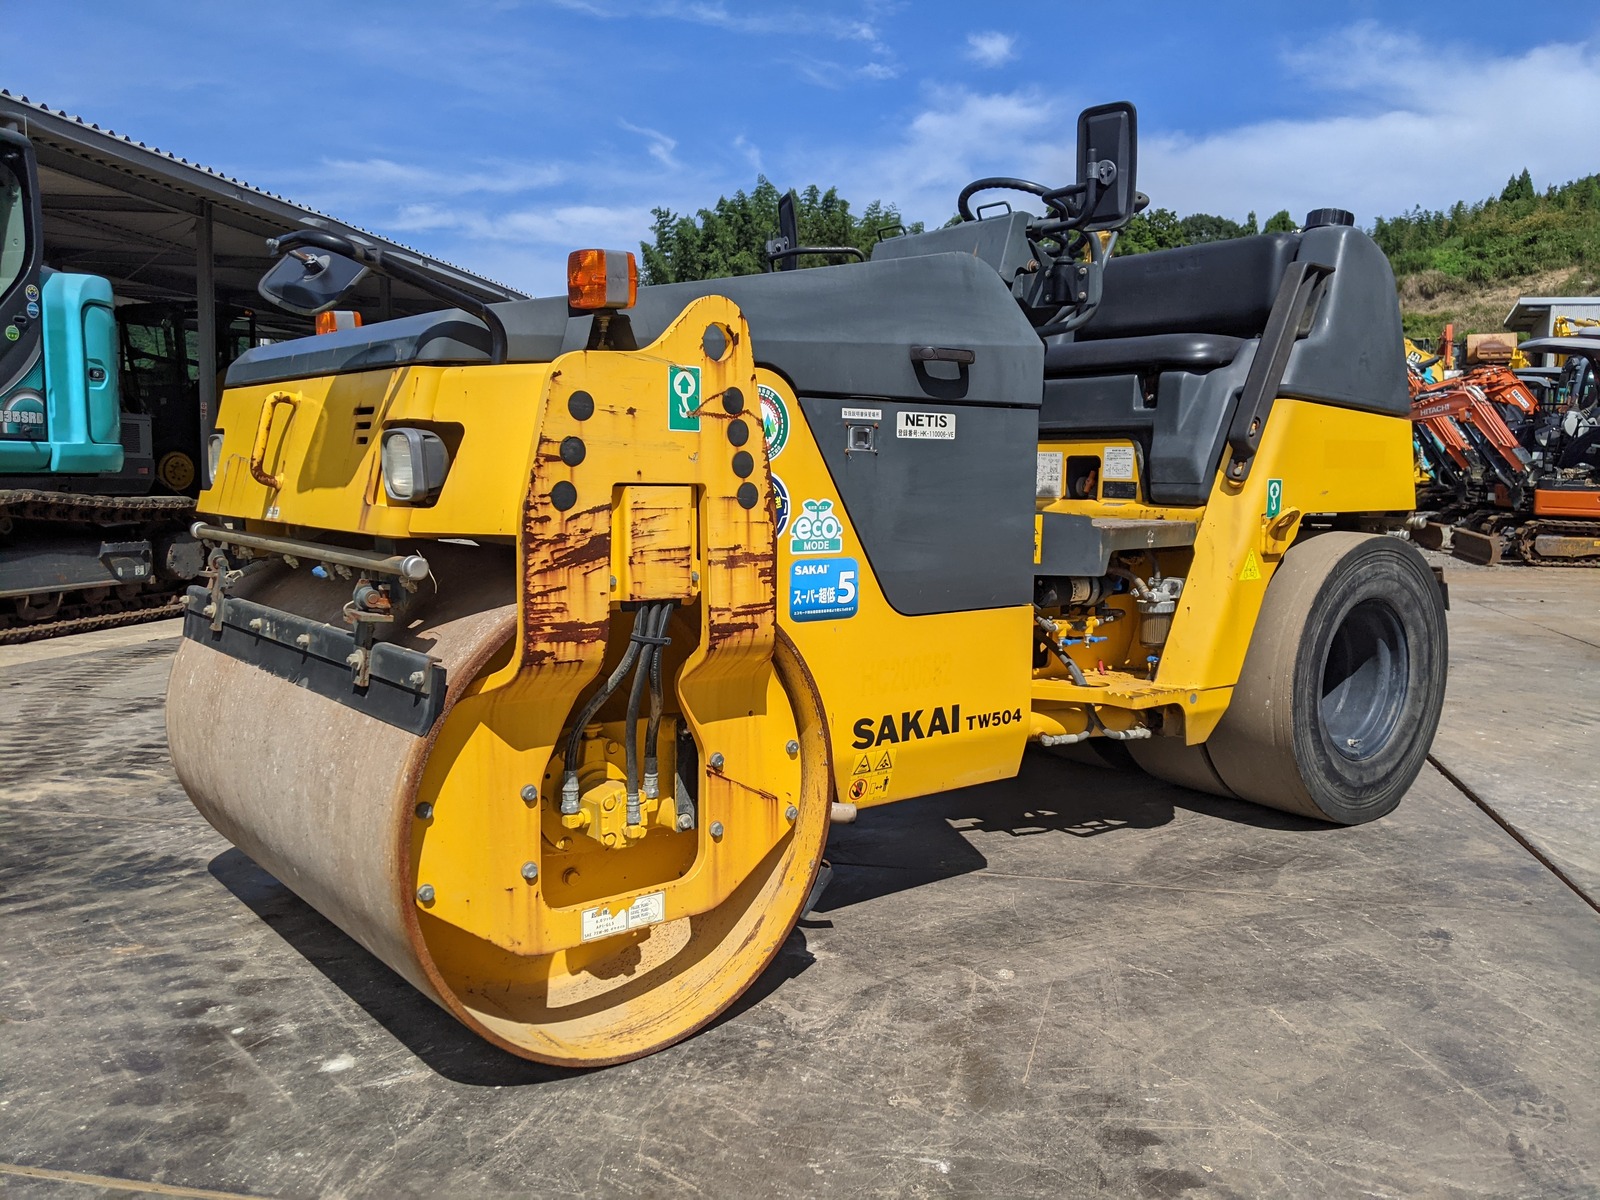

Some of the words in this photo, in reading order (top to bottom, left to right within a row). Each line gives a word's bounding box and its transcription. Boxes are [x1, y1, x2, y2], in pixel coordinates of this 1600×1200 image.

[1420, 403, 1450, 417] HITACHI
[905, 413, 948, 428] NETIS
[796, 517, 839, 540] eco
[803, 540, 830, 550] MODE
[794, 564, 828, 575] SAKAI
[793, 586, 836, 605] スーパー超低
[837, 570, 856, 604] 5
[851, 704, 960, 750] SAKAI
[966, 708, 1022, 730] TW504
